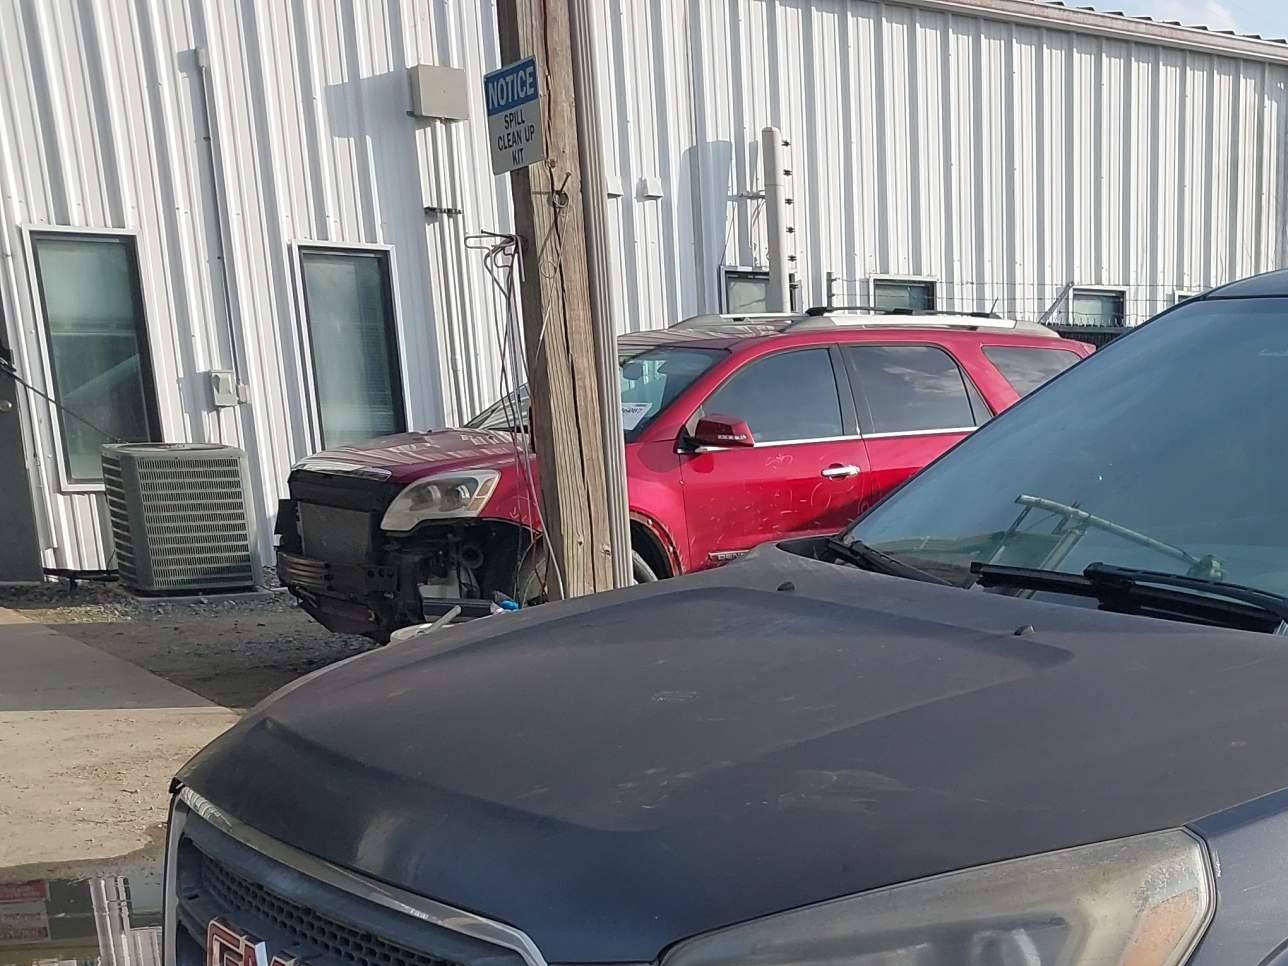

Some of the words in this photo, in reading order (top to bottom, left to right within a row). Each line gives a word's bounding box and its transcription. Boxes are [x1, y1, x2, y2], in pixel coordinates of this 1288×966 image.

[488, 66, 535, 110] NOTICE
[504, 110, 525, 130] SPILL
[498, 131, 522, 151] CLEAN
[524, 124, 535, 142] UP
[512, 148, 523, 167] KIT
